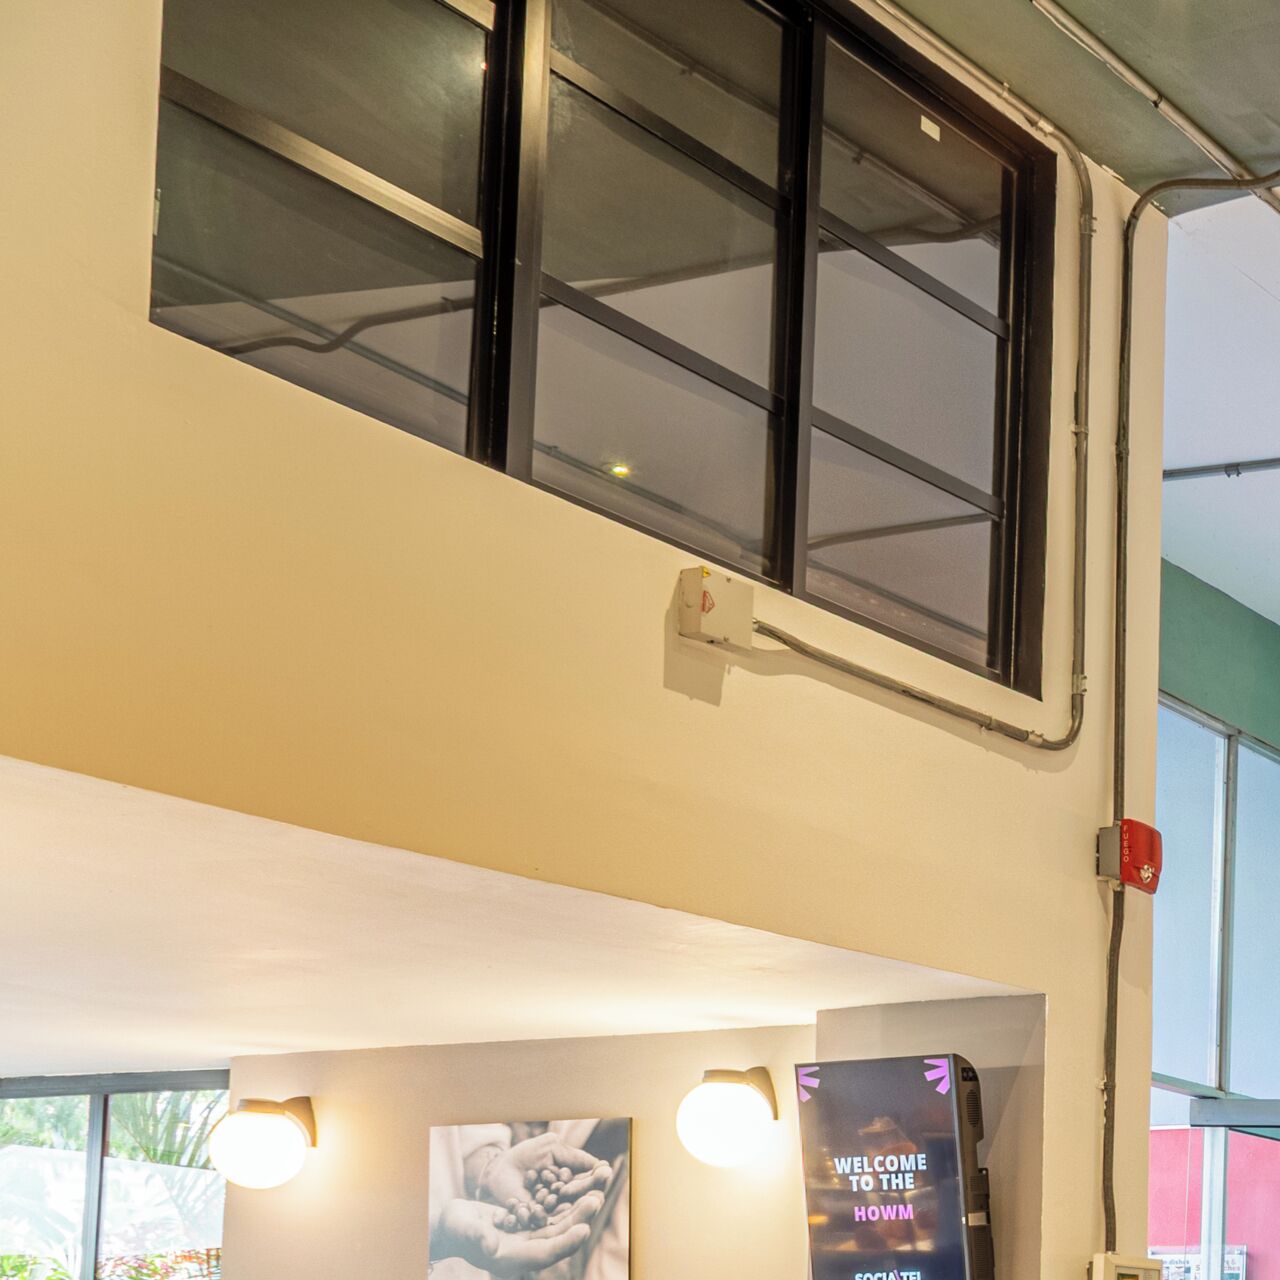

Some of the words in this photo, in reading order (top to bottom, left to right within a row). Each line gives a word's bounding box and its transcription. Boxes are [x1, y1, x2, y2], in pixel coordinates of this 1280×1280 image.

[833, 1153, 928, 1174] WELCOME
[849, 1174, 874, 1192] TO
[879, 1173, 915, 1191] THE
[854, 1204, 914, 1222] HOWM
